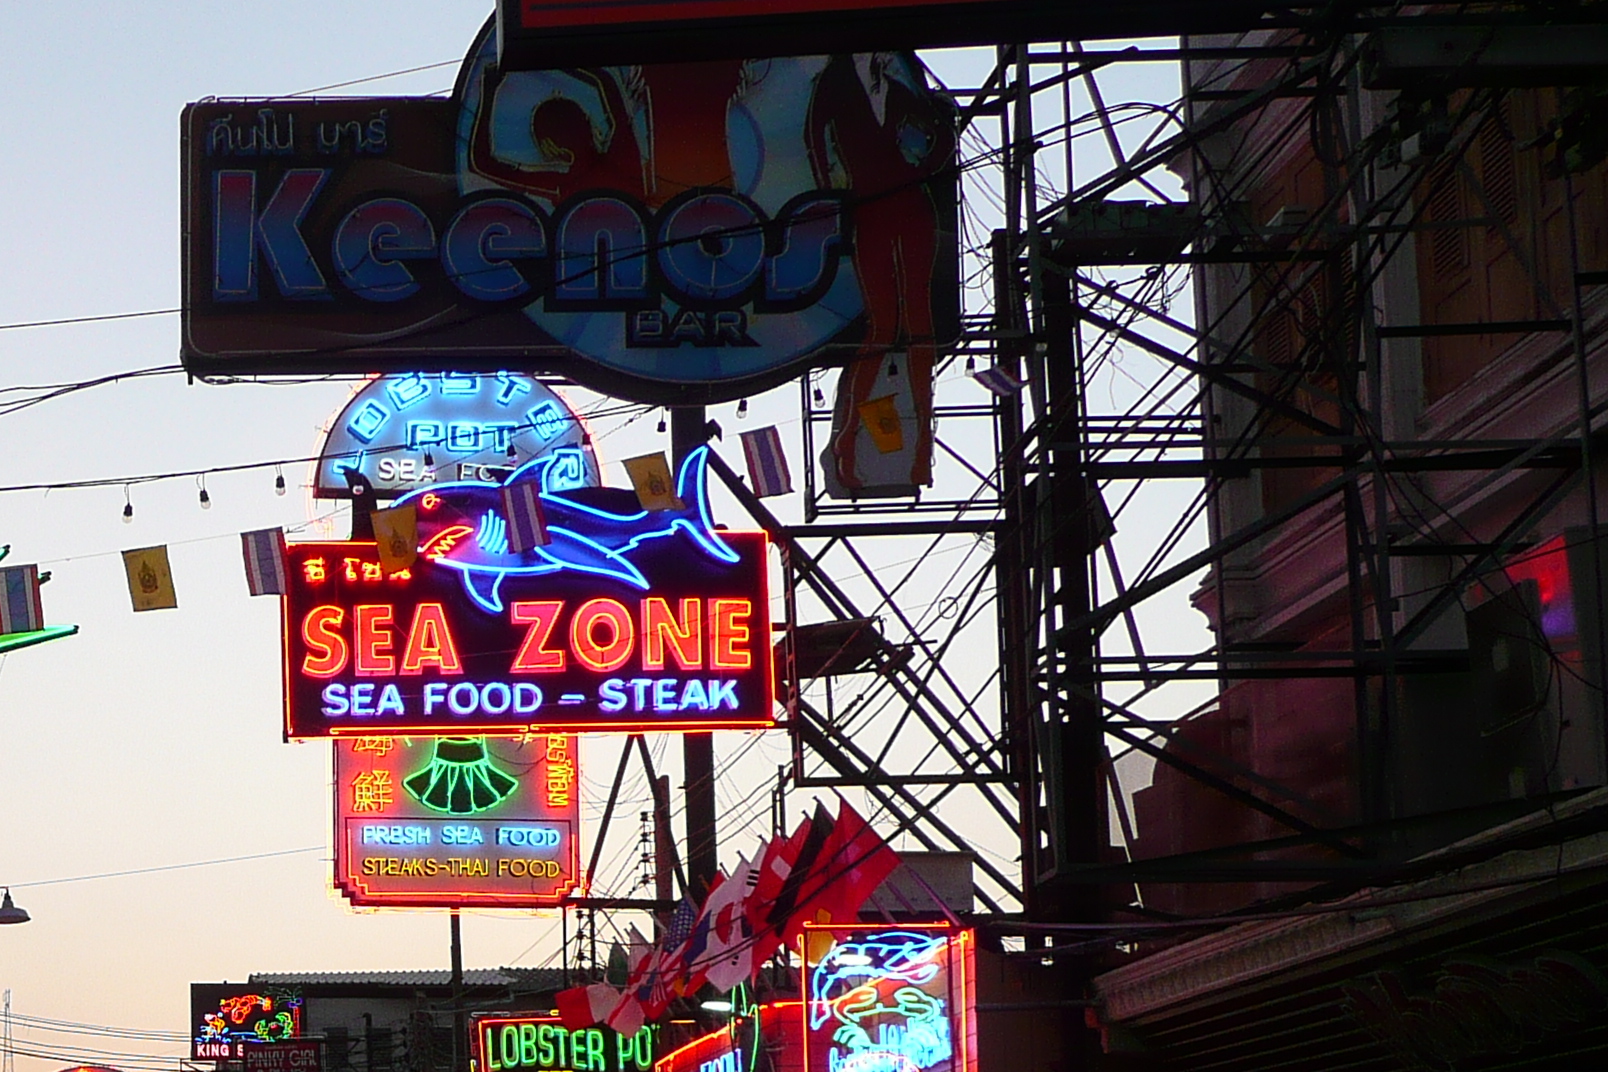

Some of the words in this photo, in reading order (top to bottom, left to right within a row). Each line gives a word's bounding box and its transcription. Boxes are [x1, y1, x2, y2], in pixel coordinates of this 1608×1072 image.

[629, 308, 749, 345] BAR
[406, 420, 518, 452] POT
[379, 457, 437, 482] SEA
[301, 602, 464, 678] SEA
[509, 597, 752, 673] ZONE
[320, 682, 405, 716] SEA
[423, 681, 543, 715] FOOD
[598, 678, 739, 712] STEAK
[362, 825, 431, 845] FRESH
[441, 825, 484, 845] SEA
[496, 825, 561, 847] FOOD
[496, 858, 561, 878] FOOD
[196, 1043, 230, 1058] KING
[246, 1050, 286, 1068] PINKY
[485, 1023, 606, 1072] LOBSTER
